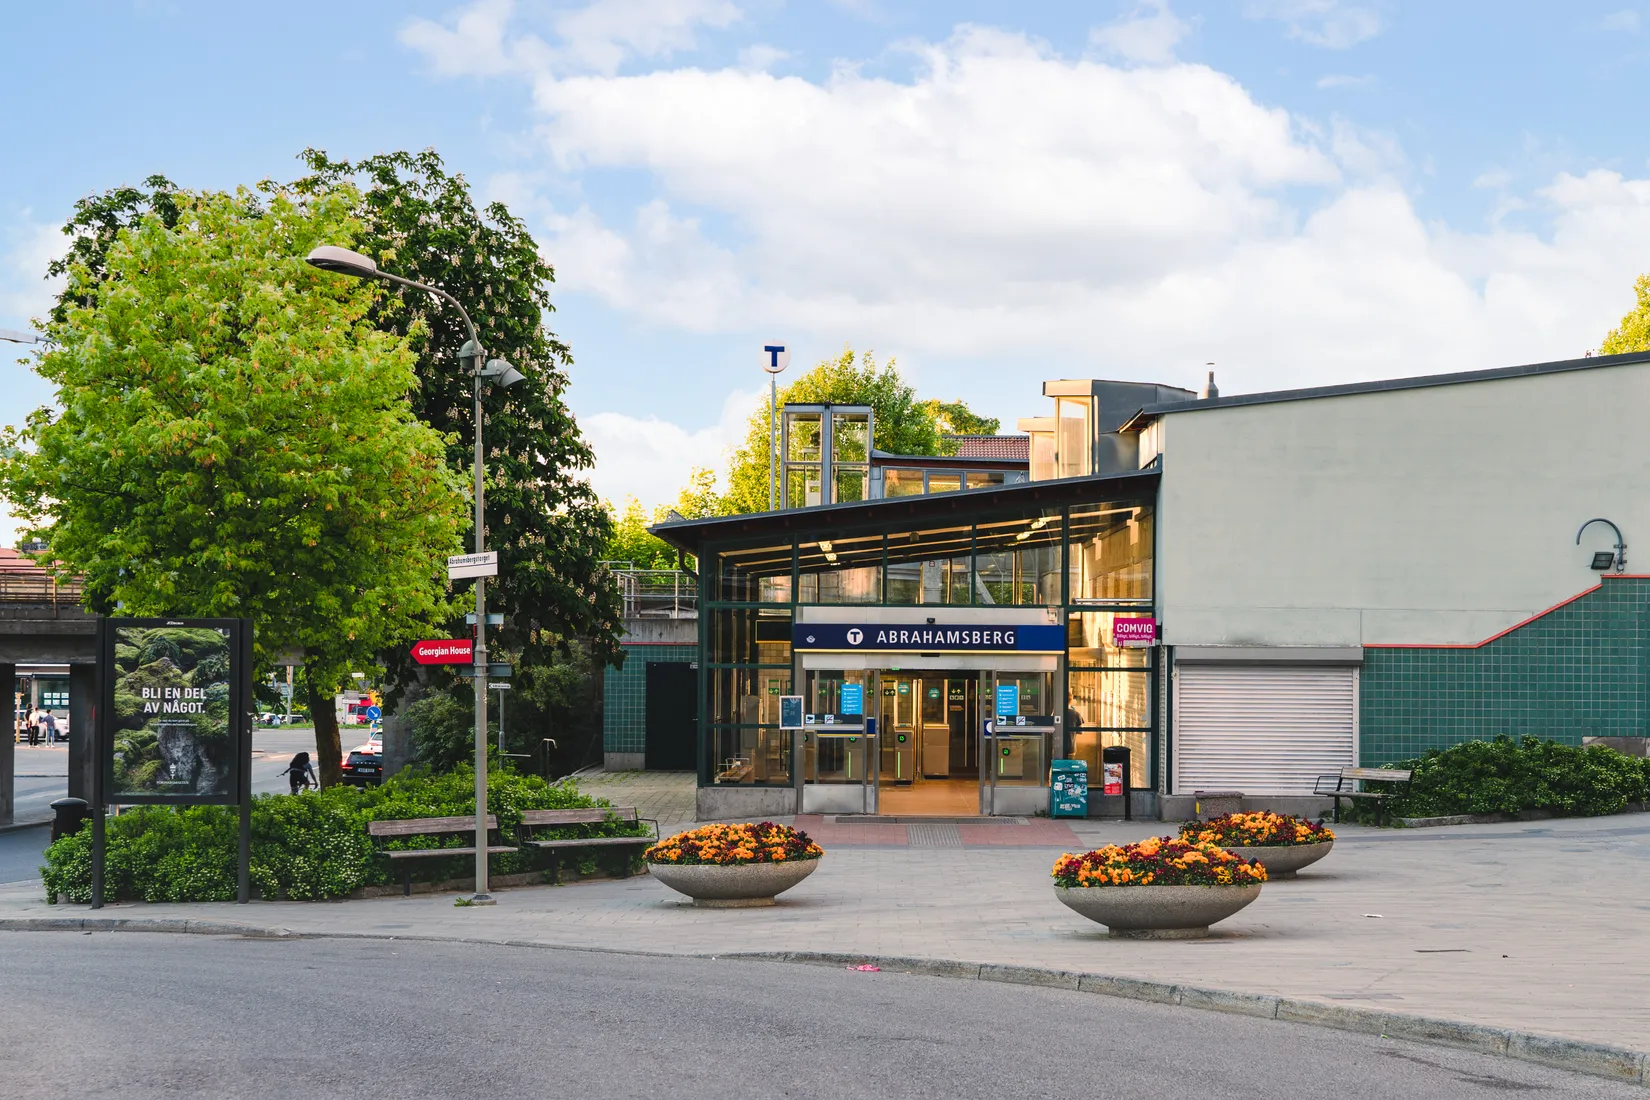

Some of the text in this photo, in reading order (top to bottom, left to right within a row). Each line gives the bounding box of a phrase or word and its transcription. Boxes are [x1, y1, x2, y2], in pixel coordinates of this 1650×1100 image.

[764, 345, 785, 367] T
[449, 555, 491, 564] Abrahamsbergstorget
[1116, 623, 1153, 633] COMVIQ
[850, 630, 1015, 644] T ABRAHAMSBERG
[419, 646, 470, 657] Georgian House
[142, 687, 207, 699] BLI EN DEL
[144, 700, 206, 713] AV NÅGOT.
